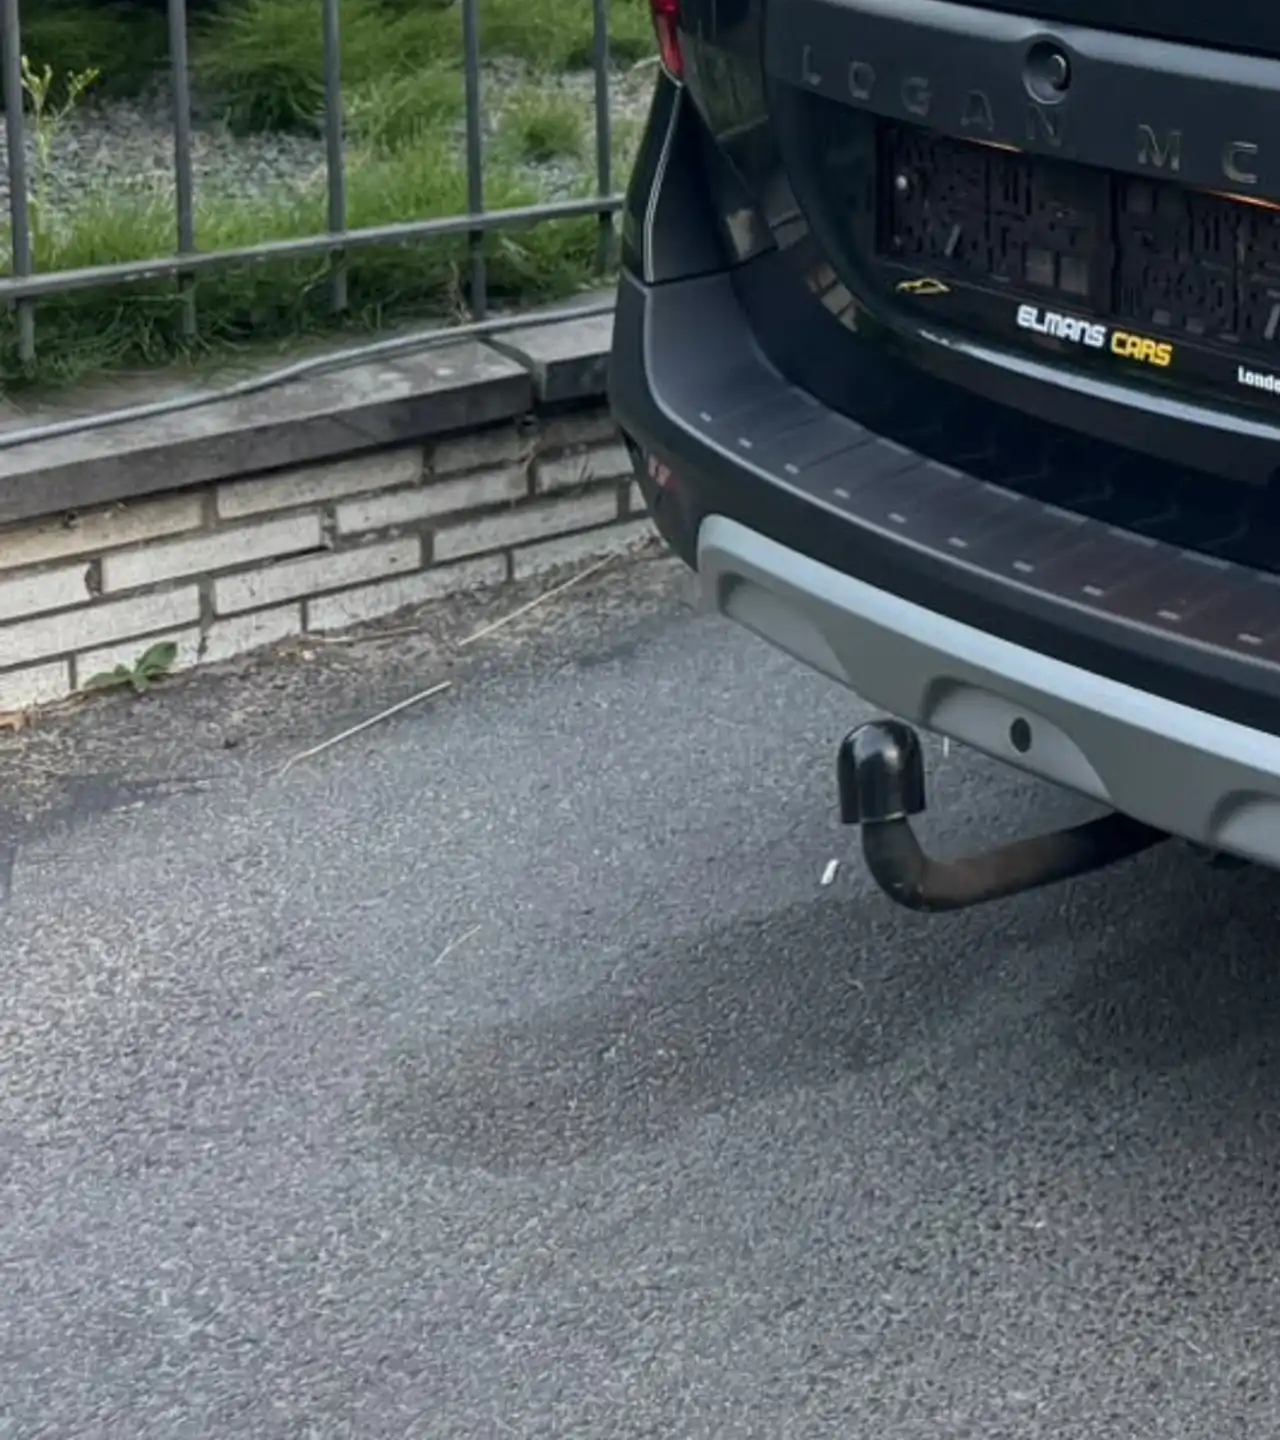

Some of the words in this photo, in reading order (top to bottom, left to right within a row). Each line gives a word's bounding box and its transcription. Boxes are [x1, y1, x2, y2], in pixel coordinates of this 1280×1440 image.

[802, 44, 1064, 147] LOGAN
[1016, 304, 1107, 347] ELMANS
[1111, 330, 1174, 367] CARS
